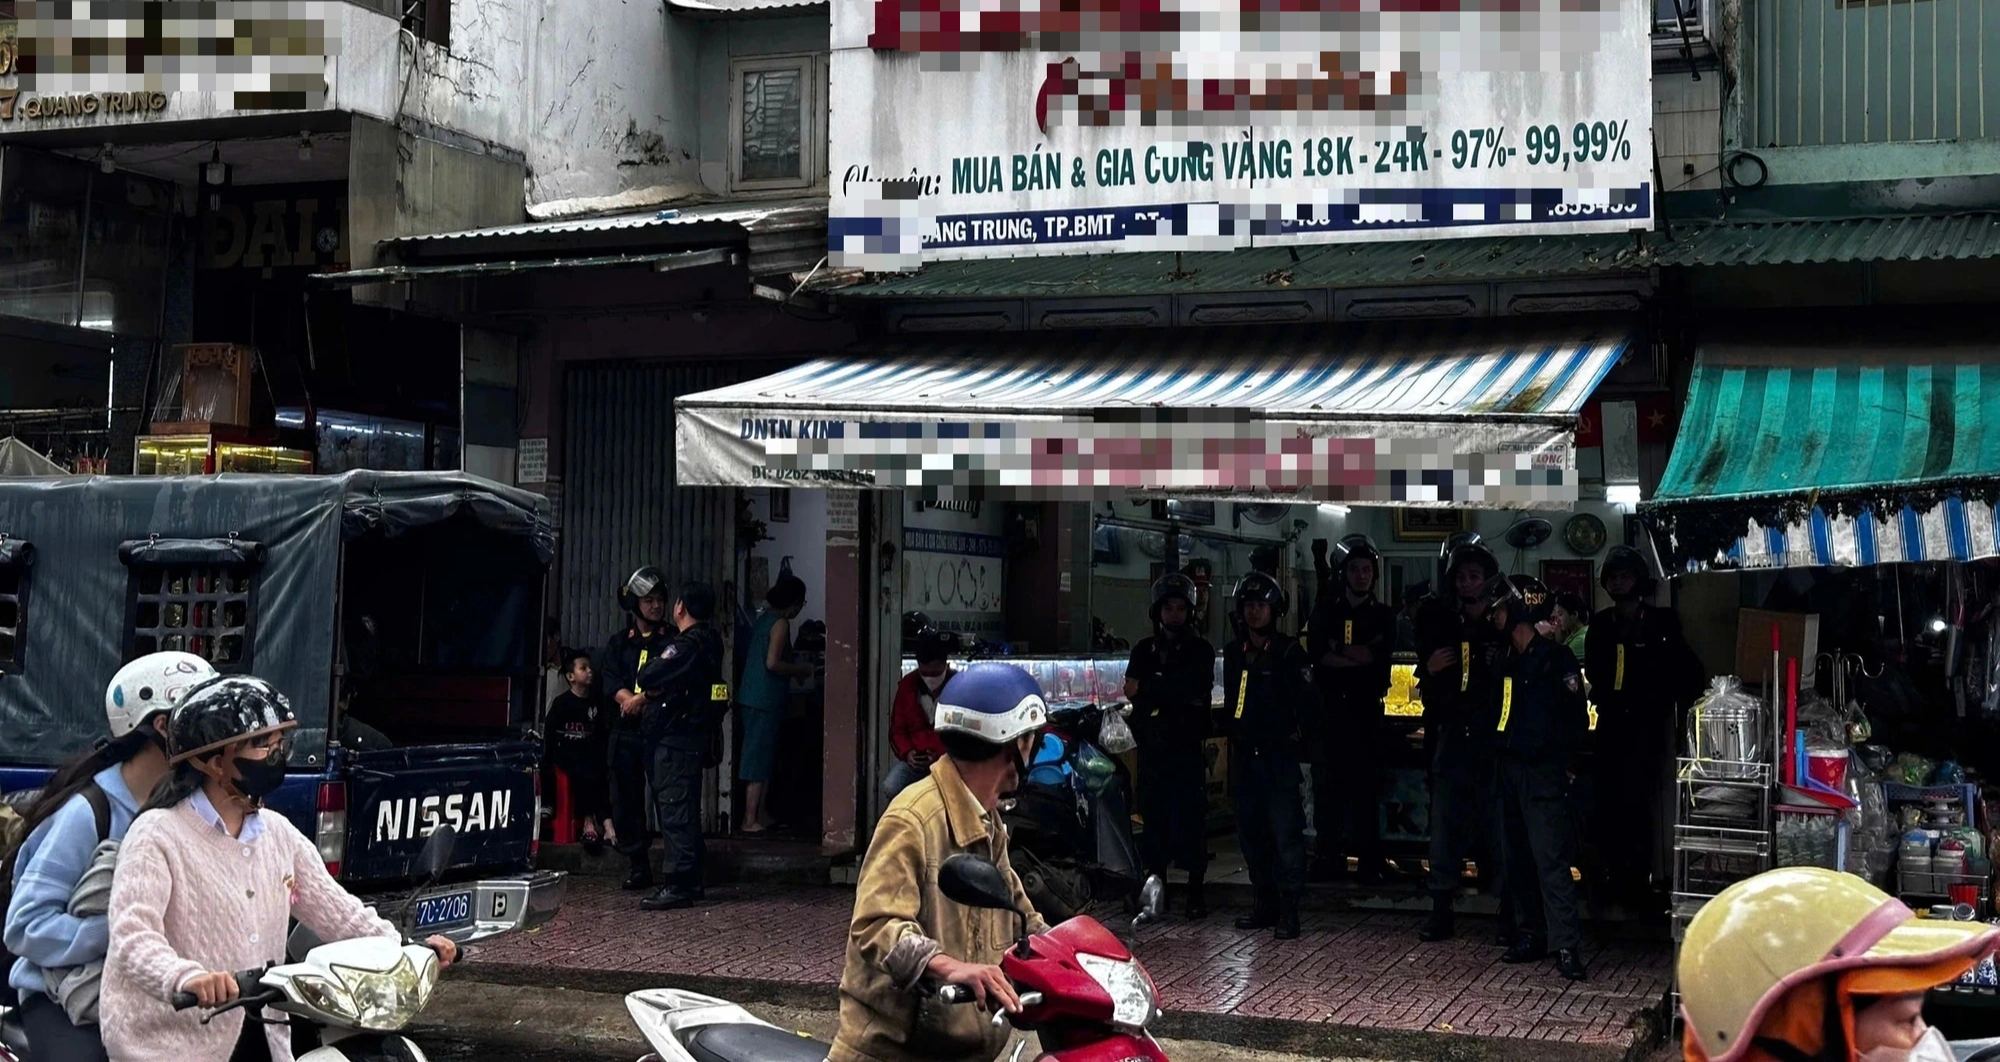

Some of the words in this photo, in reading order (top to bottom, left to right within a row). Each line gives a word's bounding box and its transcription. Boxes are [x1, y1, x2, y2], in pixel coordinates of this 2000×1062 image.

[25, 94, 99, 118] QUANG
[102, 91, 167, 113] TRUNG
[951, 155, 1003, 195] MUA
[1012, 143, 1061, 192] BÁN
[1070, 156, 1086, 188] &
[1095, 147, 1136, 188] GIA
[1221, 130, 1292, 181] VÀNG
[1302, 135, 1354, 178] 18K
[1374, 131, 1428, 174] 24K
[1525, 119, 1631, 172] 99,99%
[971, 217, 1038, 243] TRUNG,
[1044, 214, 1115, 238] TP.BMT
[741, 418, 792, 440] DNTN
[376, 789, 511, 842] NISSAN
